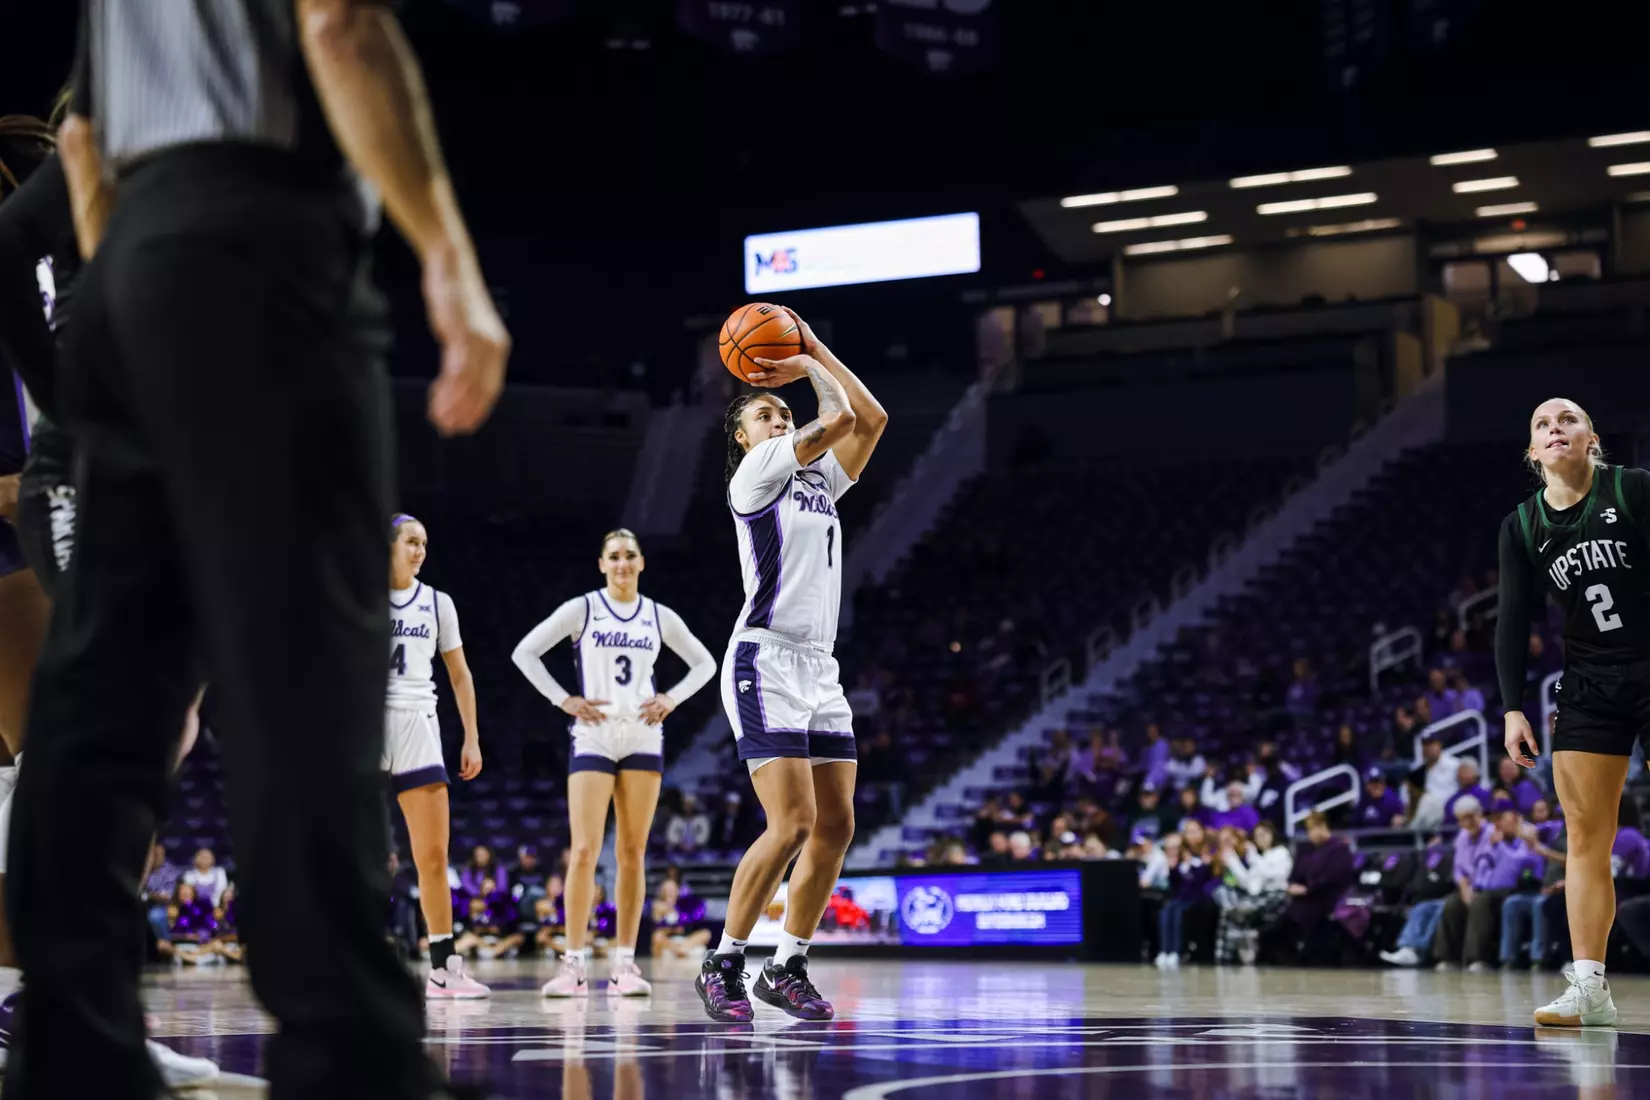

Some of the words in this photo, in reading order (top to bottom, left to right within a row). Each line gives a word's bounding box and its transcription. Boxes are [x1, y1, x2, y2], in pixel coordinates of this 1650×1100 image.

[826, 525, 835, 570] 1
[1548, 539, 1632, 591] UPSTATE
[1584, 583, 1624, 633] 2
[390, 619, 430, 639] ldcats
[592, 629, 654, 650] Wildcats
[389, 643, 407, 677] 4
[614, 654, 632, 686] 3
